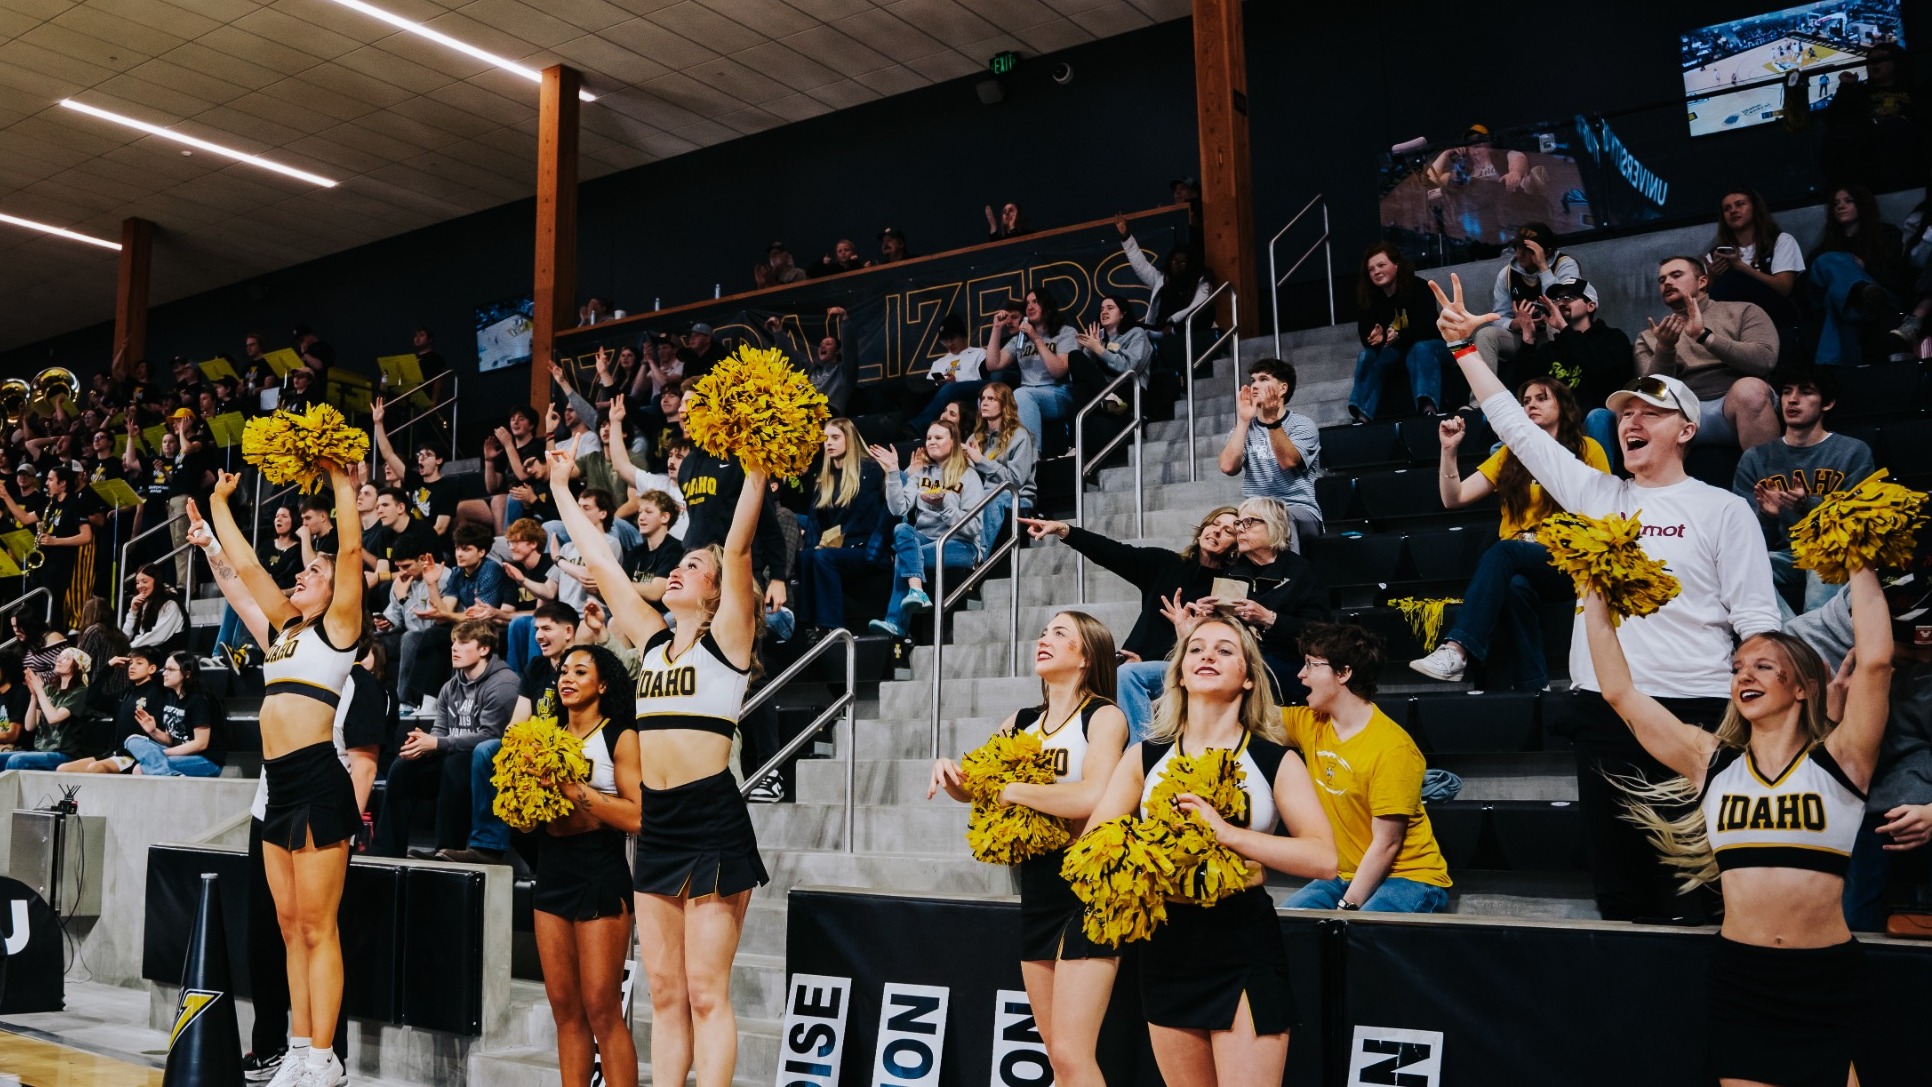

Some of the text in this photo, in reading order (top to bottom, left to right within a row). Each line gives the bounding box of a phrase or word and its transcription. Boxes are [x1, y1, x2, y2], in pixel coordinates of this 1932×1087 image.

[994, 55, 1013, 74] EXIT
[1621, 511, 1686, 538] mot
[264, 639, 300, 663] DAHO
[1716, 792, 1827, 833] IDAHO
[784, 984, 843, 1087] ISE
[879, 993, 941, 1087] ON
